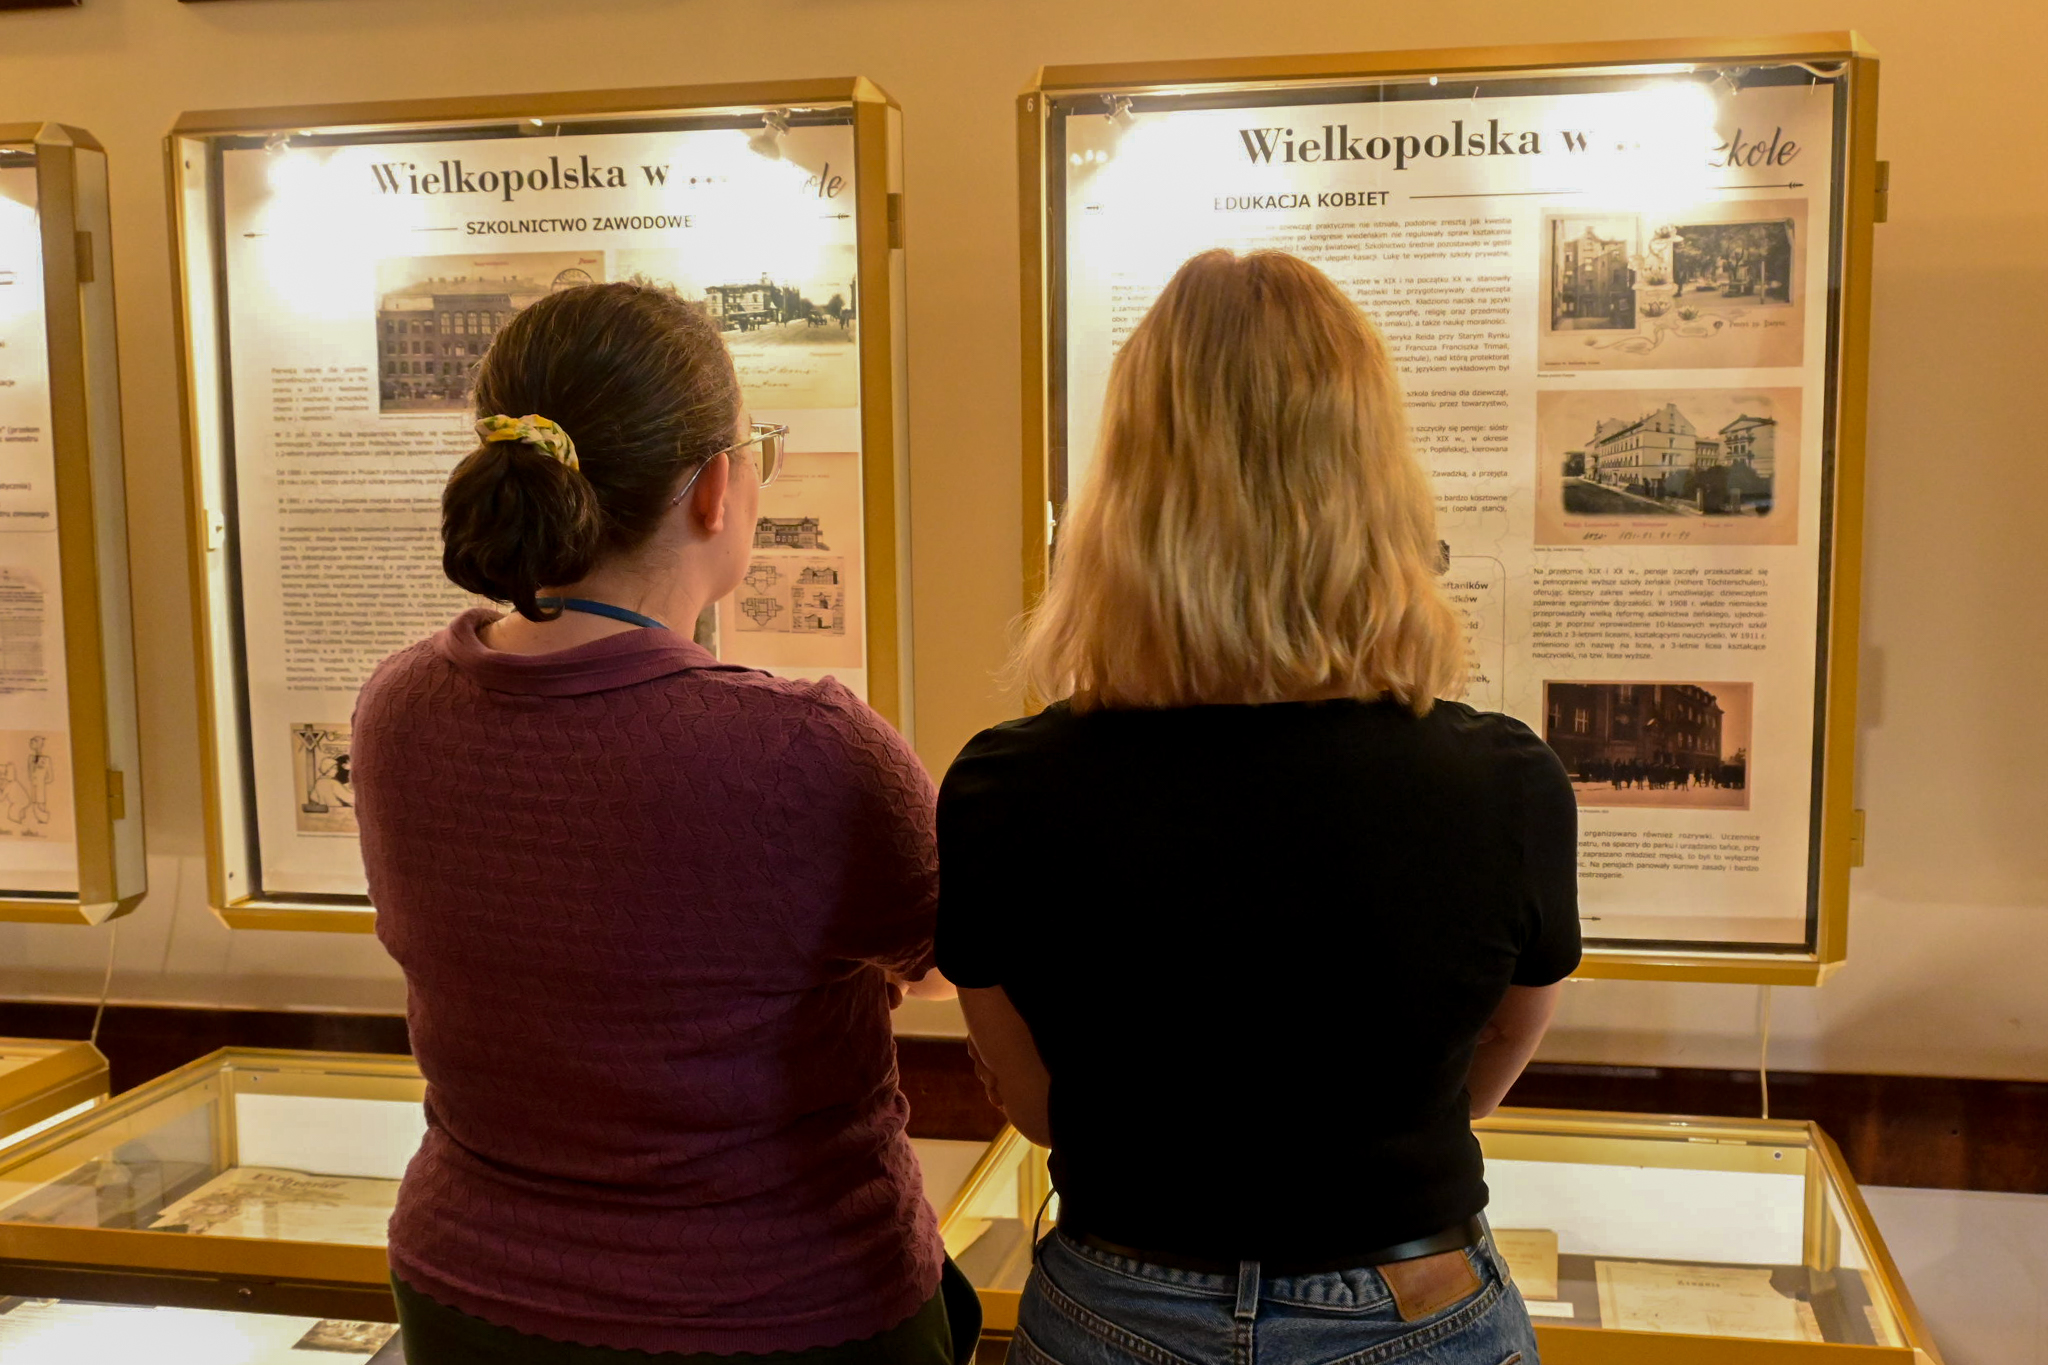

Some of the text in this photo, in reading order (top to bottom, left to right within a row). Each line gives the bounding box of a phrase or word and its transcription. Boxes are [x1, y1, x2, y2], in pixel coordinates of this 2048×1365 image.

[1026, 97, 1034, 112] 6
[1239, 118, 1542, 171] Wielkopolska
[370, 155, 628, 202] Wielkopolska
[641, 164, 670, 187] w
[1213, 191, 1390, 210] EDUKACJA KOBIET
[466, 215, 693, 235] SZKOLNICTWO ZAWODOWE
[1457, 332, 1484, 341] Starym
[1486, 332, 1511, 341] Rynku
[1448, 354, 1468, 363] którą
[1469, 354, 1510, 363] protektorat
[1400, 364, 1510, 375] lat, językiem wykładowym był
[1430, 389, 1457, 397] średnia
[1471, 389, 1509, 398] dziewcząt,
[1438, 400, 1509, 409] przez towarzystwo,
[1416, 424, 1446, 433] szczyciły
[1448, 424, 1458, 433] się
[1452, 505, 1477, 514] (opłata
